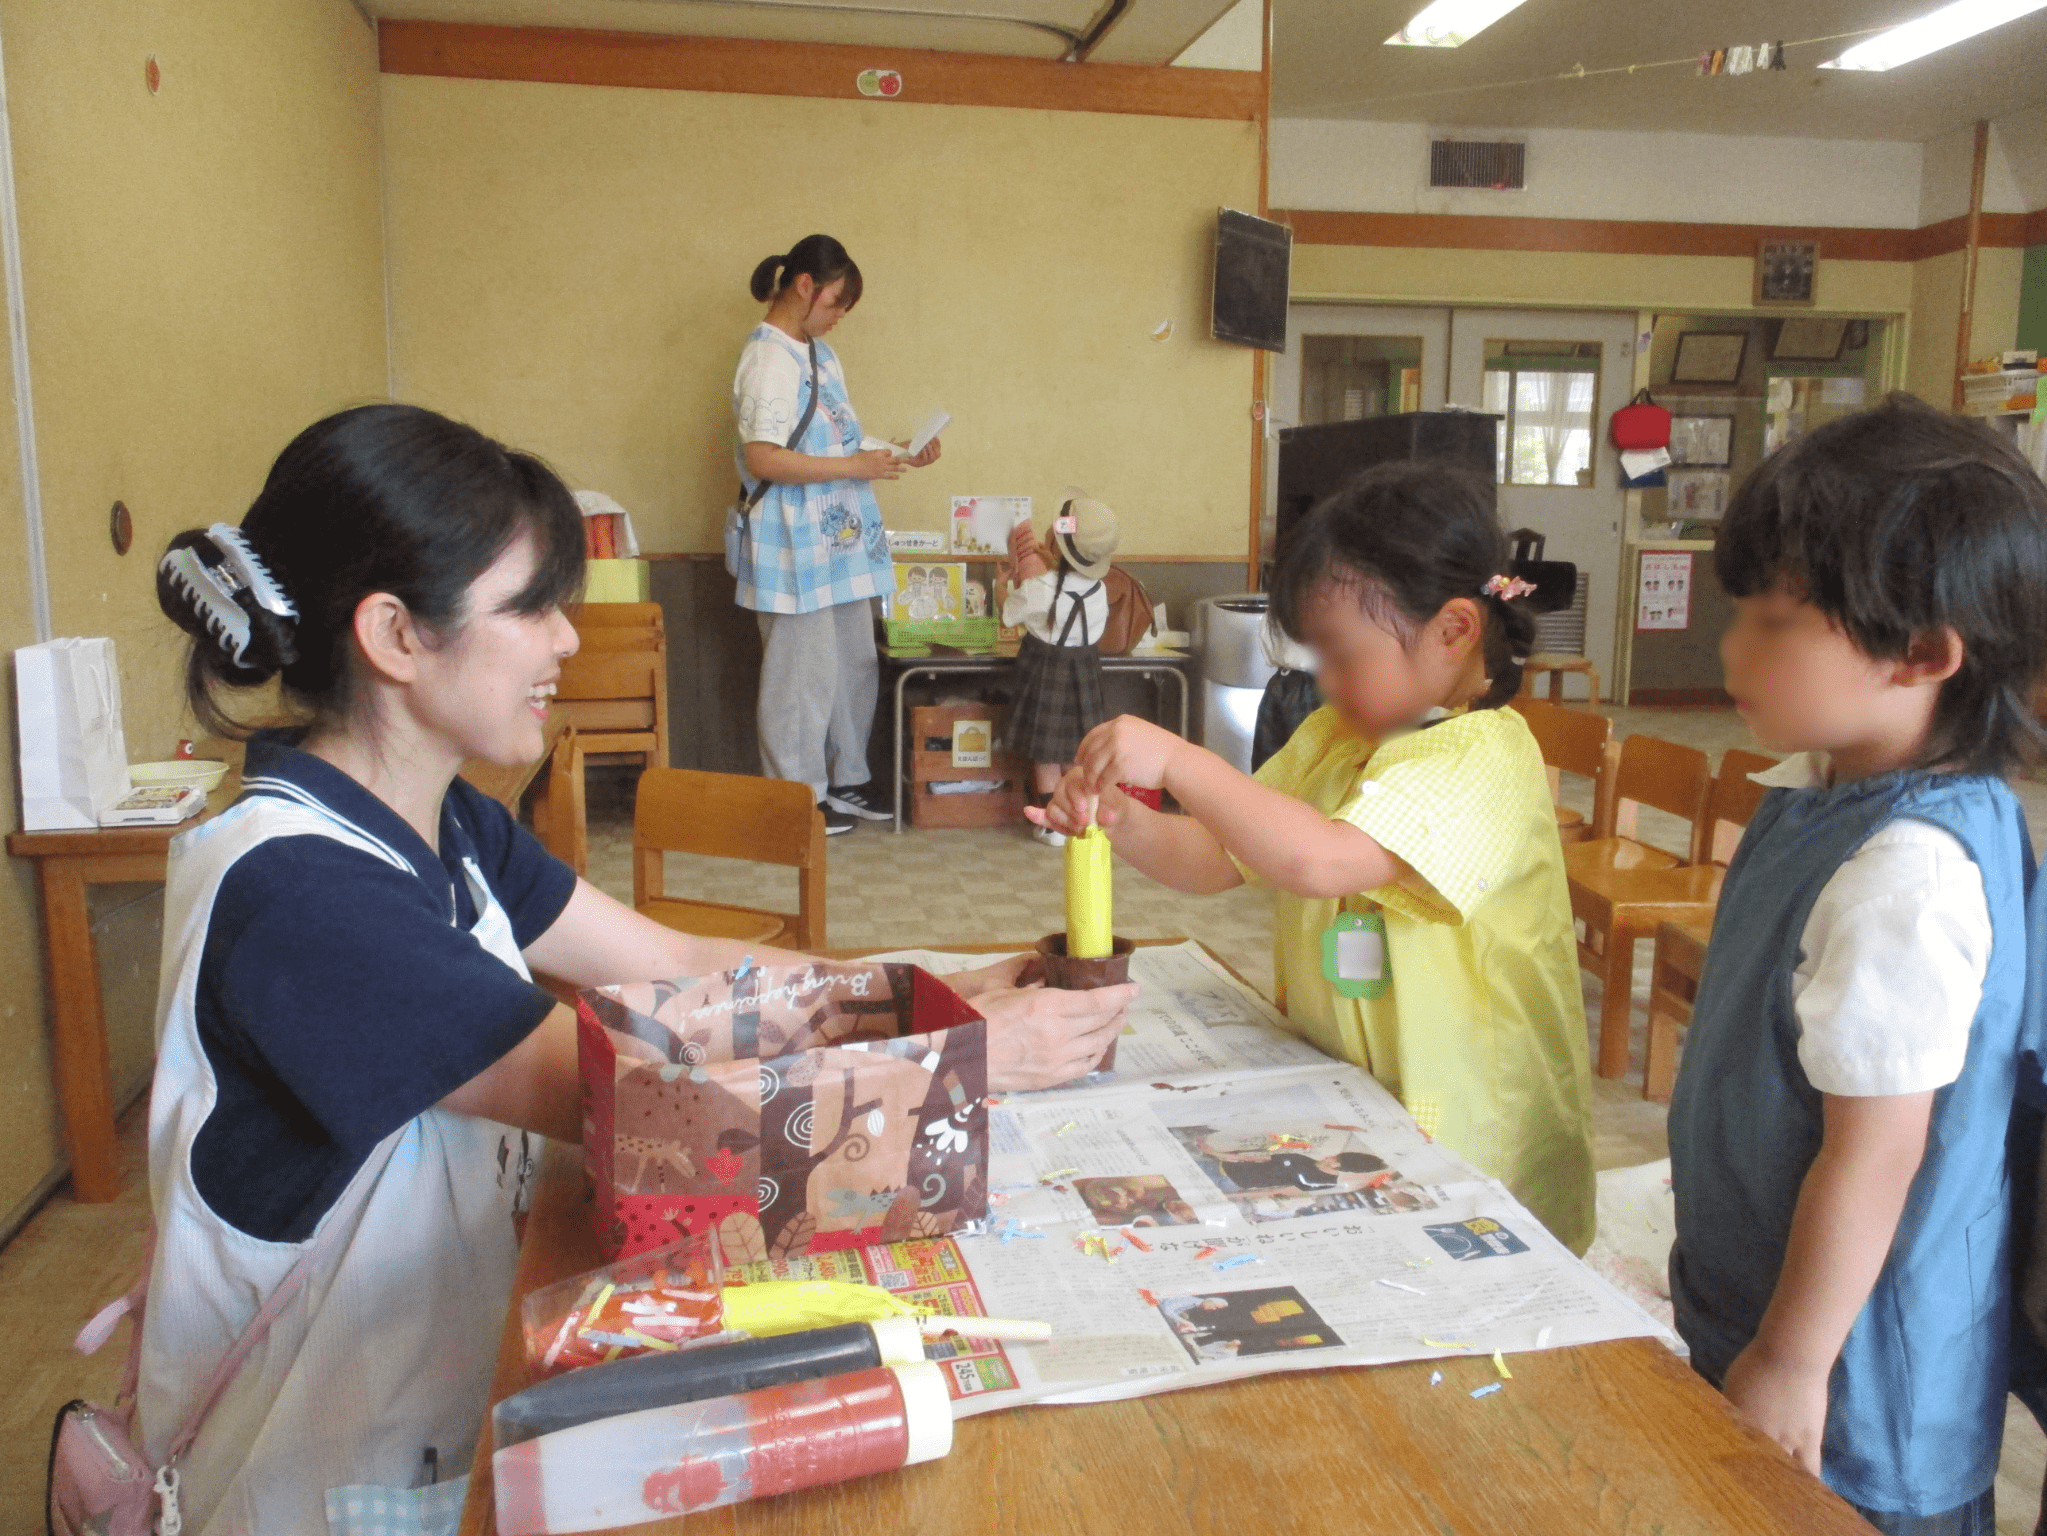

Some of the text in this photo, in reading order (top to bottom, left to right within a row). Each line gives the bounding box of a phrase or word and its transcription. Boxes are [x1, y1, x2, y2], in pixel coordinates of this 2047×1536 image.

[887, 538, 939, 548] しゅっせきかーど
[678, 967, 874, 1034] Bring happiness!
